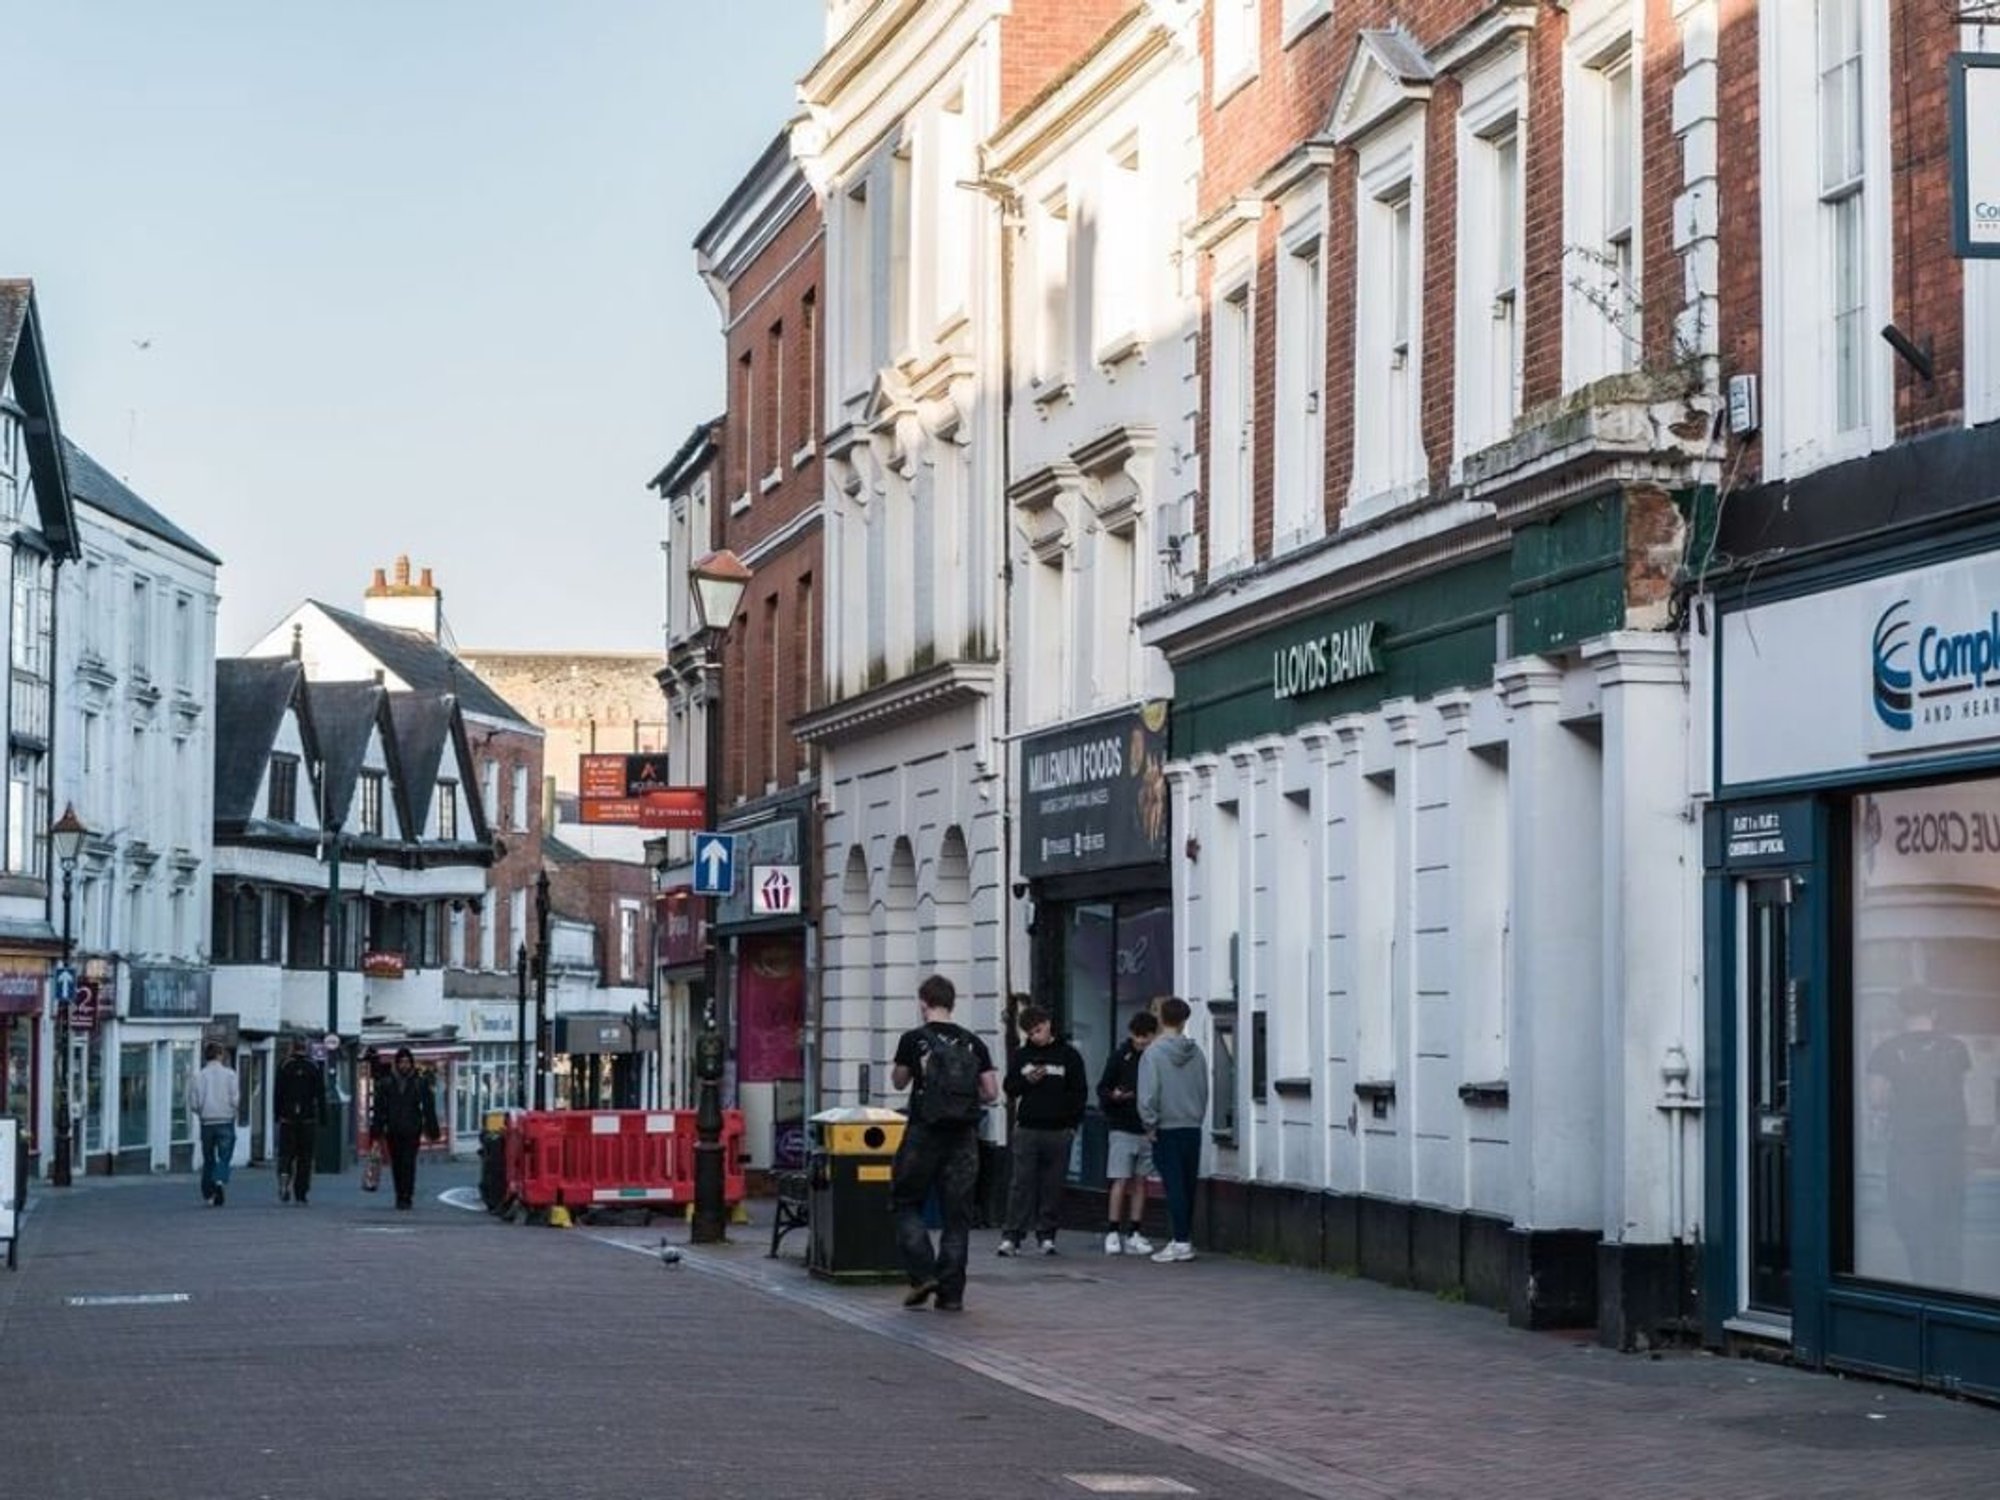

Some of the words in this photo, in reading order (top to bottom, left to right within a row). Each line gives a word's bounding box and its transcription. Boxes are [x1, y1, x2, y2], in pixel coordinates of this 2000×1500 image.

[1274, 636, 1327, 699] LLOYDS
[1330, 620, 1375, 684] BANK
[1924, 703, 1952, 723] AND
[1083, 736, 1122, 783] FOODS
